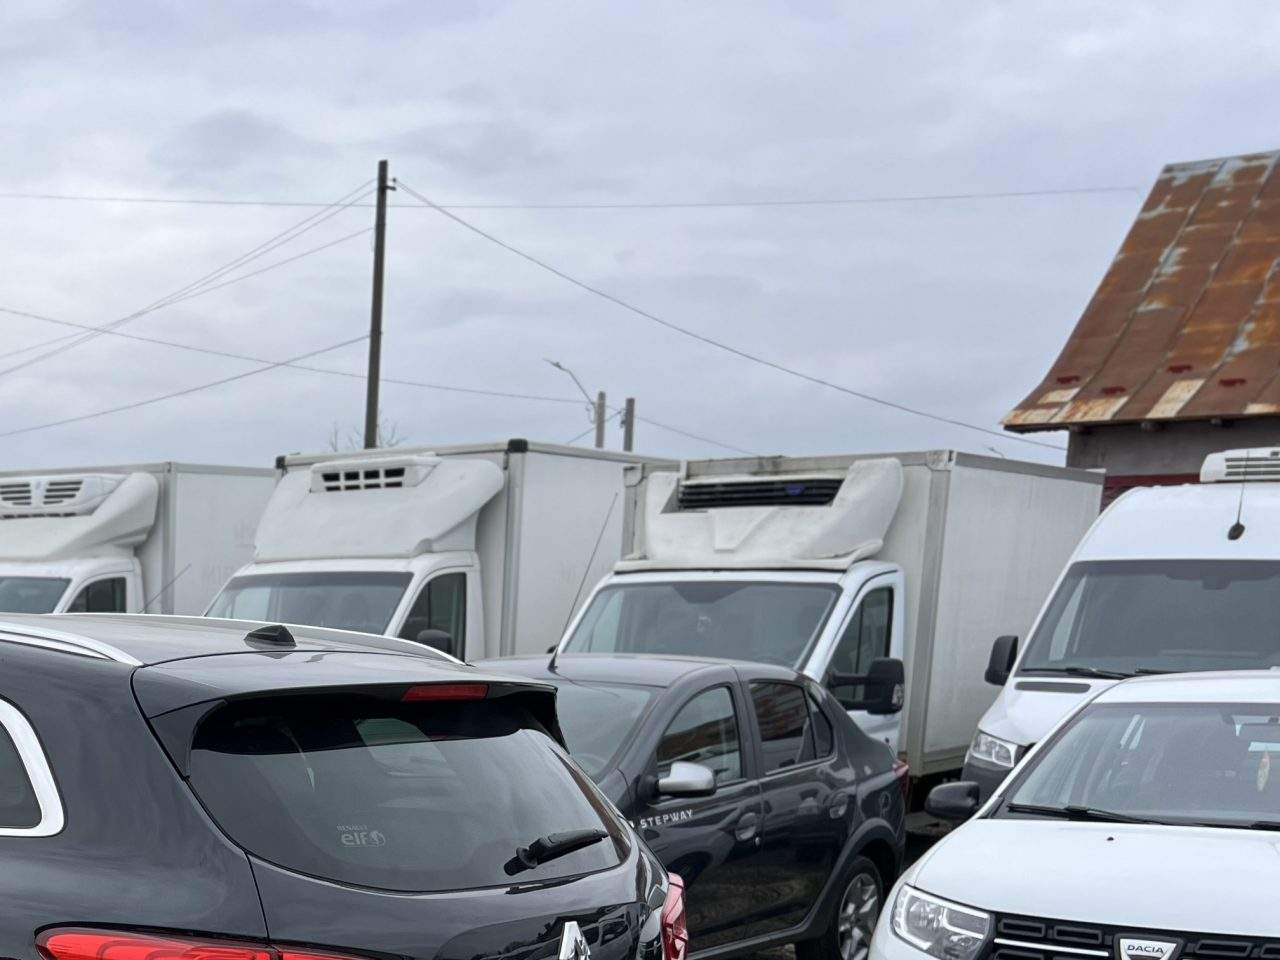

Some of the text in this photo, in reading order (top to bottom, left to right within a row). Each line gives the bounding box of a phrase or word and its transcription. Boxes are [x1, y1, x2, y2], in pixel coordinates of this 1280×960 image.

[640, 809, 693, 829] STEPWAY
[341, 832, 368, 846] elf
[1127, 944, 1164, 954] DACIA
